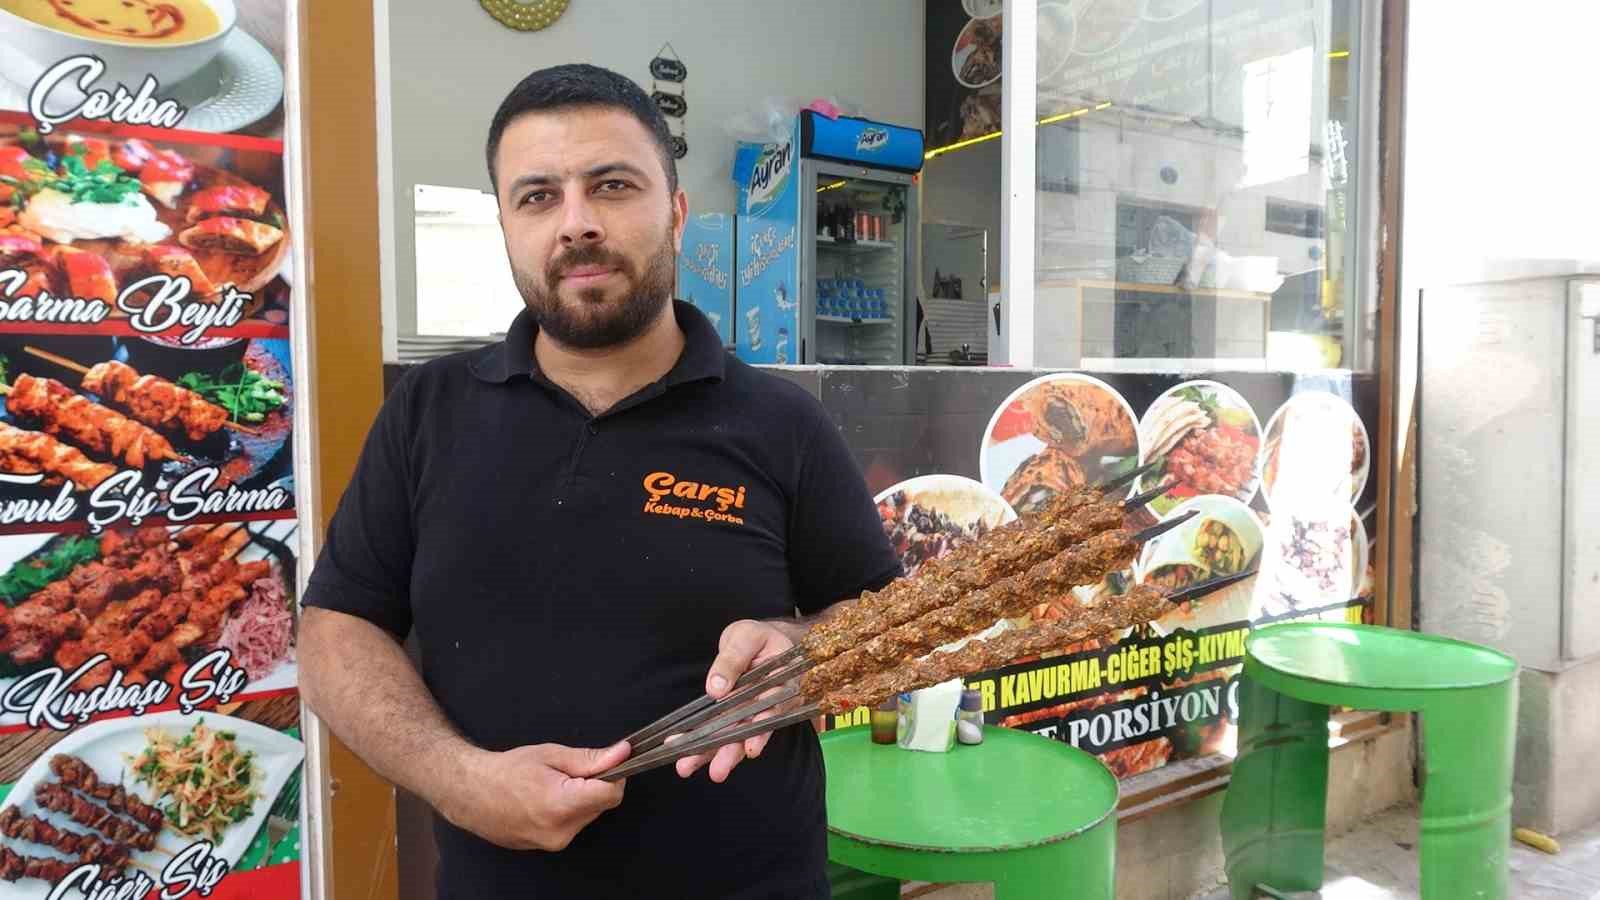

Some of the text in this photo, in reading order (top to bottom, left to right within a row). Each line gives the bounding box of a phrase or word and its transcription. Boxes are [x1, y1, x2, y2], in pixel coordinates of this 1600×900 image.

[29, 55, 185, 134] Çorba
[750, 142, 791, 195] Ayran
[118, 275, 251, 342] Beyti
[87, 469, 157, 534] Şiş
[168, 467, 288, 522] Sarma
[643, 471, 747, 511] Çarşi
[3, 649, 245, 730] Kuşbaşı Şiş
[1000, 644, 1161, 709] KAVURMA-CİĞER
[1068, 685, 1221, 749] PORSİYON
